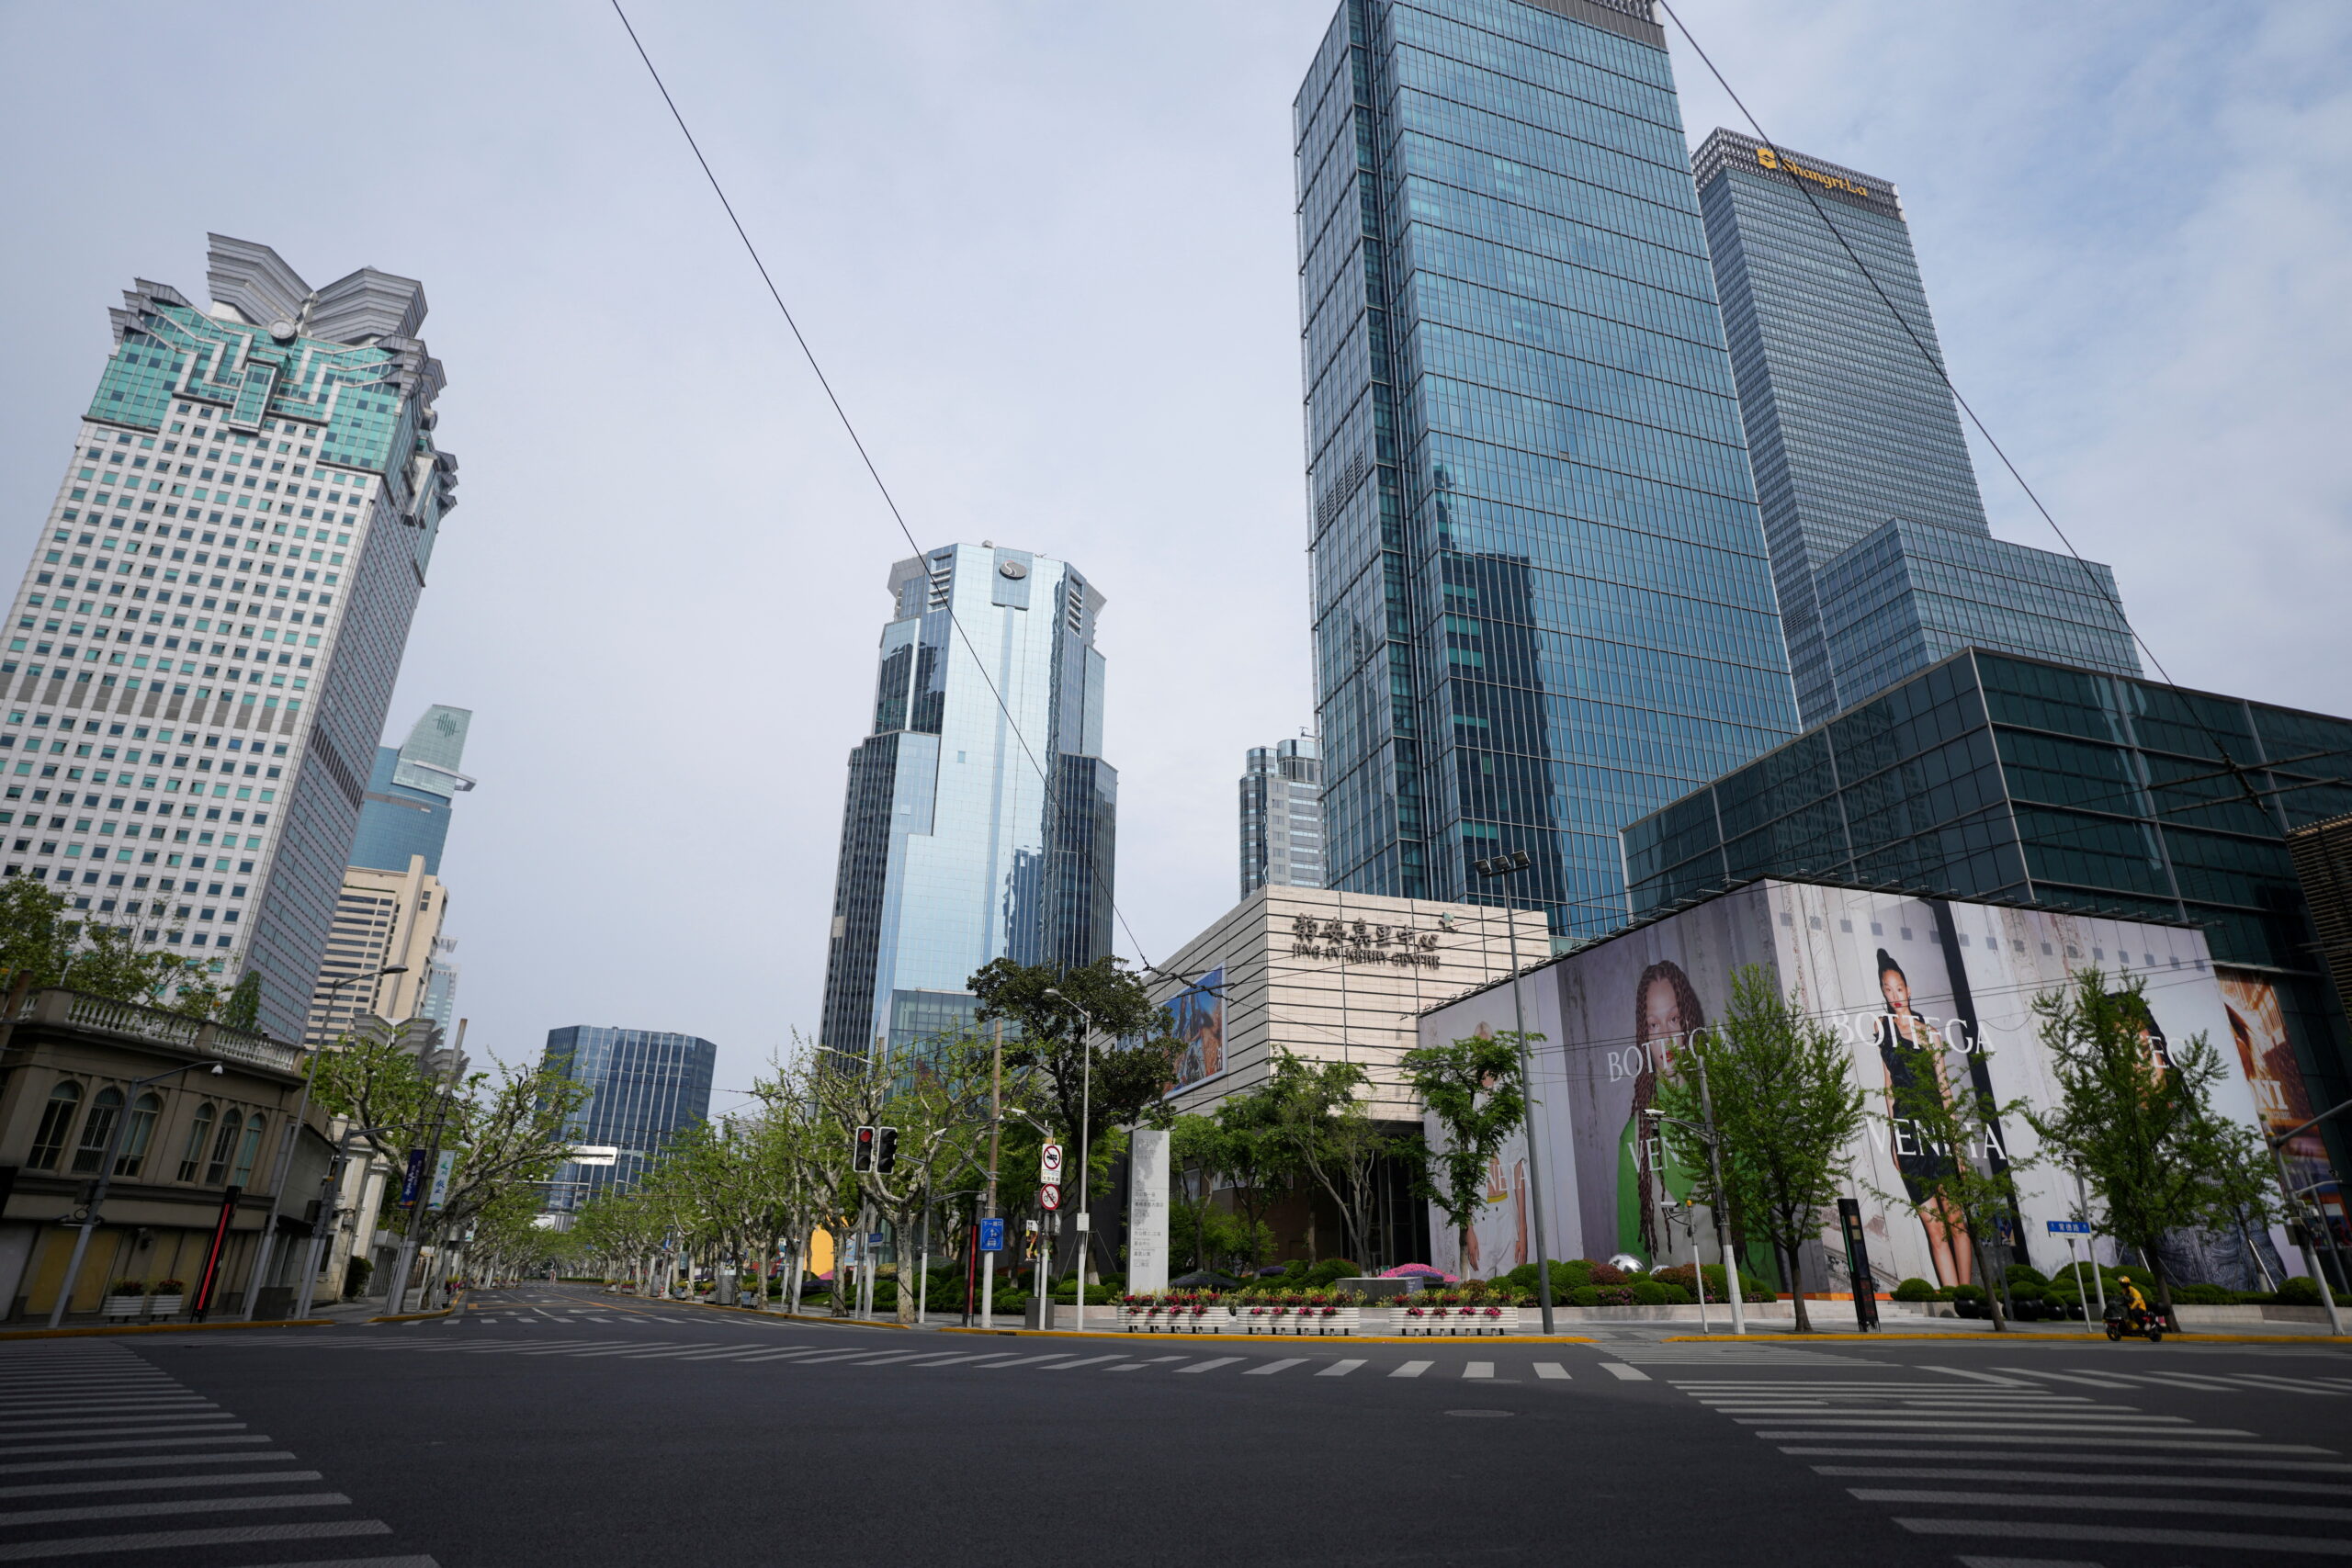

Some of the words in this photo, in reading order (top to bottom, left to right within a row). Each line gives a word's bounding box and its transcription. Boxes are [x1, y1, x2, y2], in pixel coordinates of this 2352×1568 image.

[1782, 159, 1867, 197] Shangri-La
[1293, 912, 1439, 952] 静安嘉里中心
[1345, 948, 1389, 965] KERRY
[1391, 952, 1441, 970] CENTRE
[1830, 1009, 1997, 1055] BOTTEGA
[1866, 1116, 2007, 1160] VENTA
